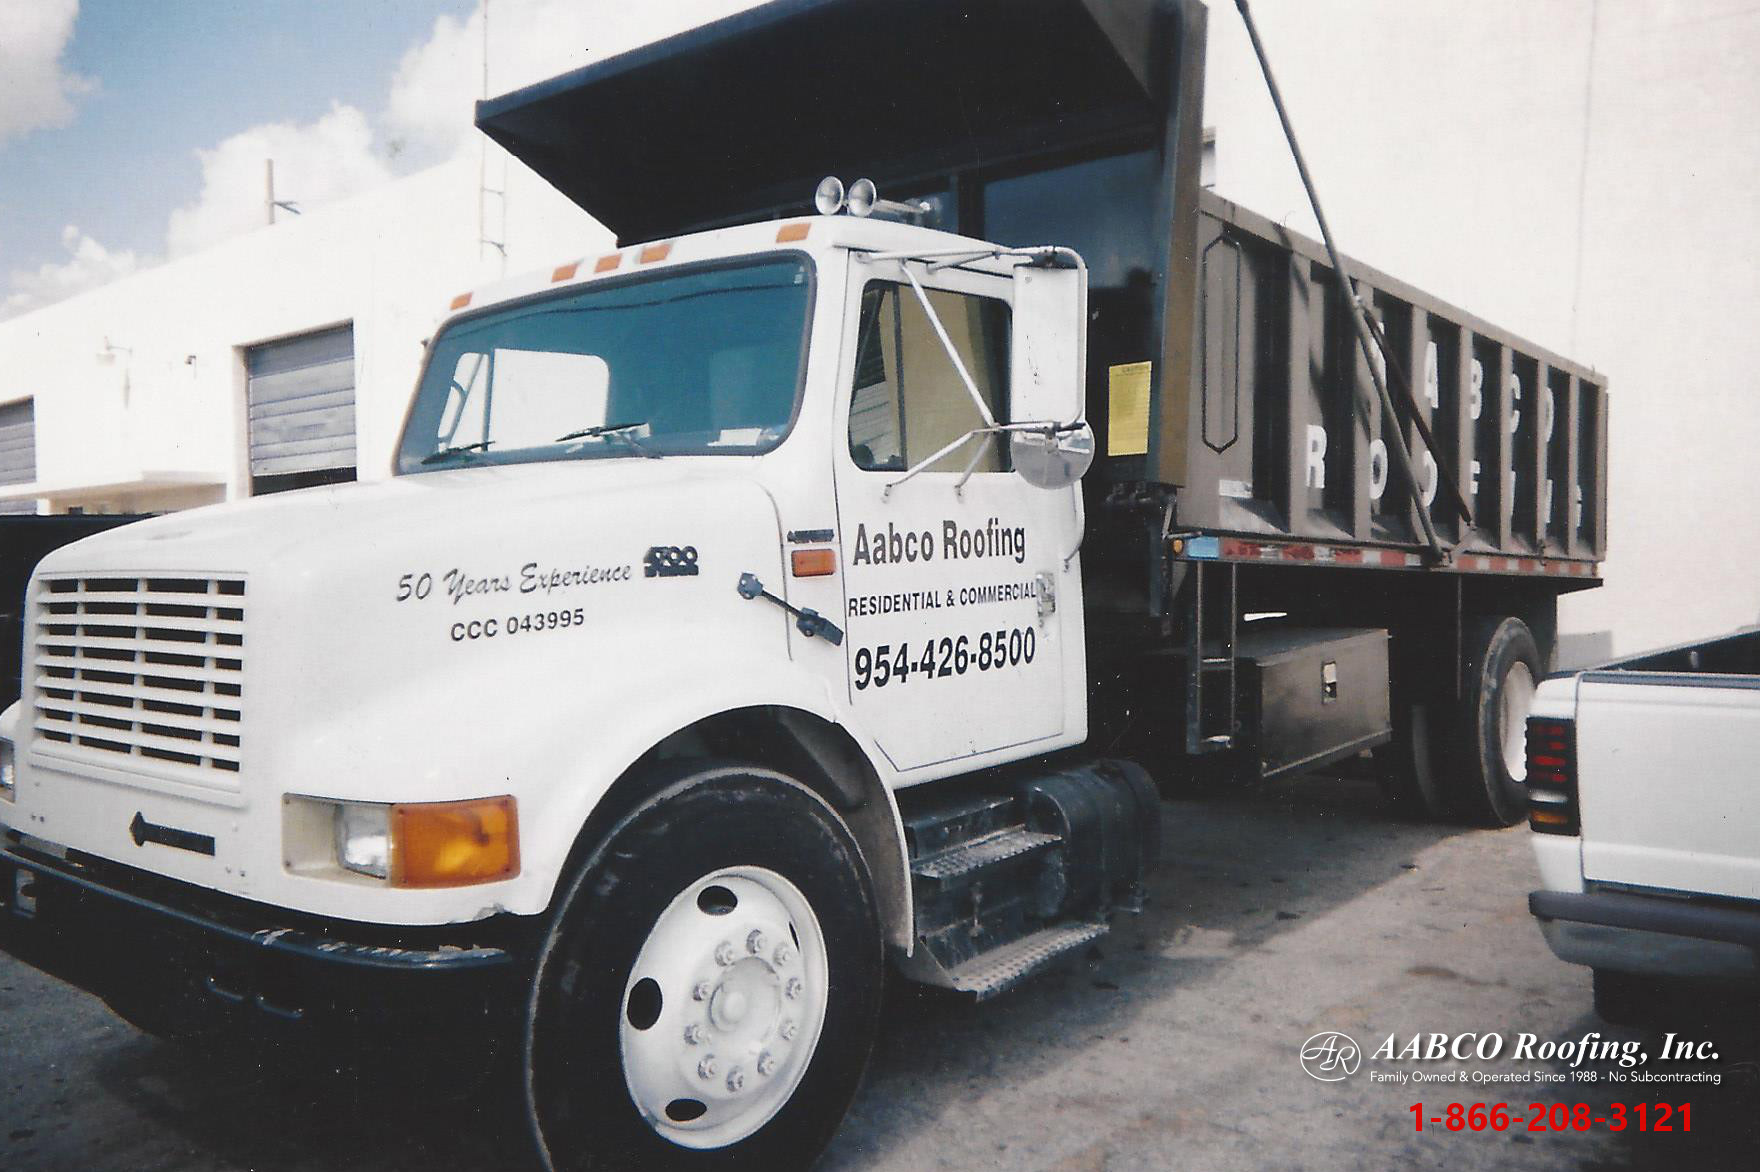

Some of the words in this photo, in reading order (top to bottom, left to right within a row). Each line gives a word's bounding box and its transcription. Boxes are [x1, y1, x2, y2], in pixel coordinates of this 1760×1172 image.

[853, 522, 934, 566] Aabco
[943, 517, 1026, 564] Roofing
[396, 572, 433, 602] 50
[443, 568, 512, 605] Years
[520, 563, 633, 595] Experience
[848, 591, 941, 617] RESIDENTIAL
[946, 590, 955, 607] &
[960, 582, 1037, 606] COMMERCIAL
[451, 618, 498, 642] CCC
[506, 608, 585, 635] 043995
[854, 626, 1036, 691] 954-426-8500
